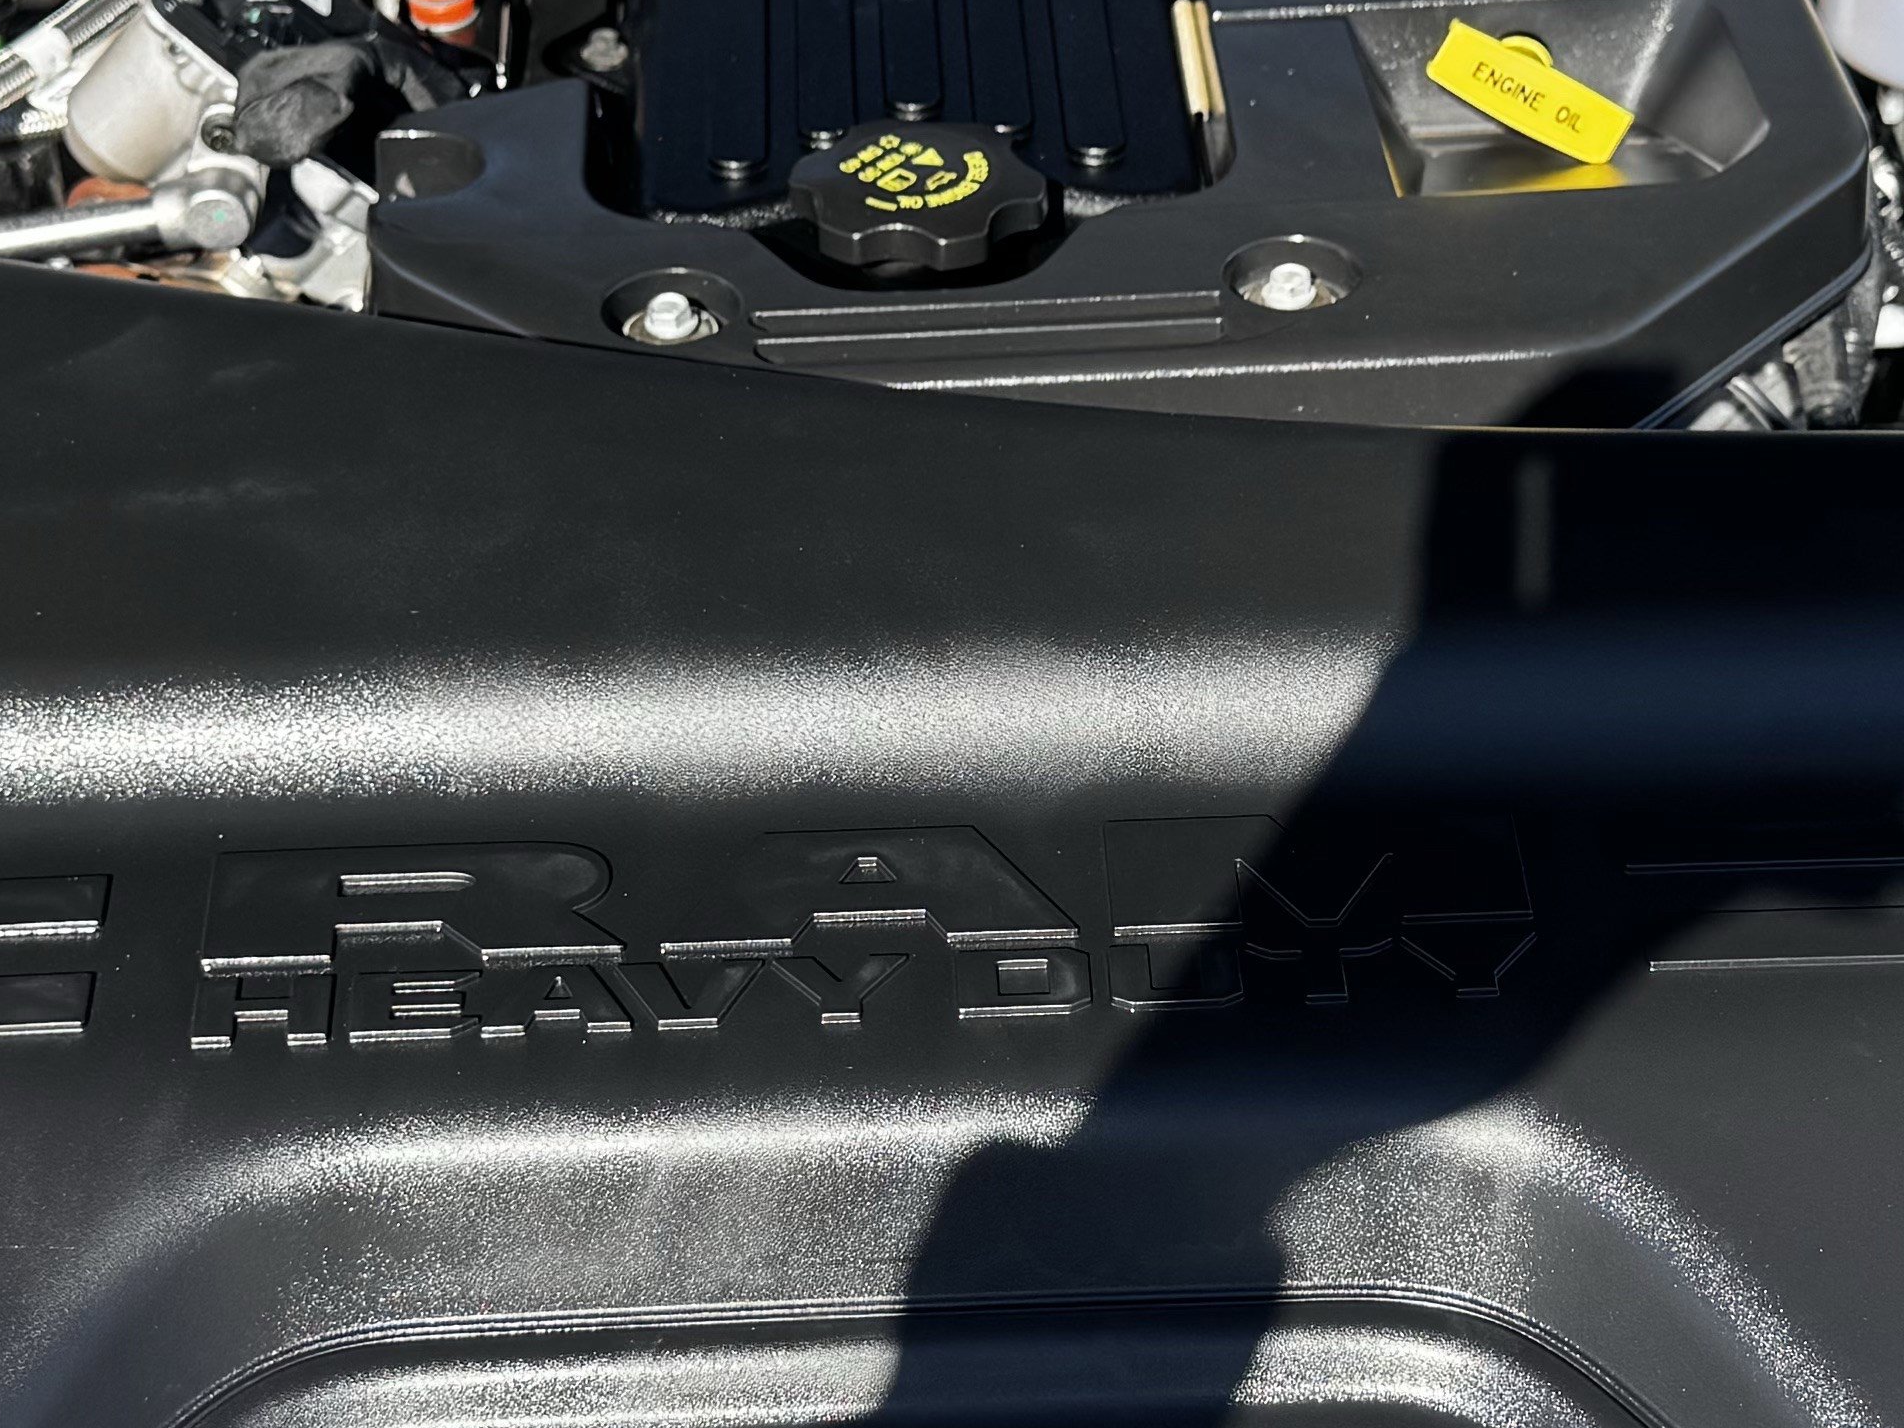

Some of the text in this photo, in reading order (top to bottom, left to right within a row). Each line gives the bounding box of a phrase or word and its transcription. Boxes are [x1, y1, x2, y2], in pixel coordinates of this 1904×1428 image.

[1471, 60, 1582, 134] ENGINE OIL
[201, 812, 1534, 976] RAM
[190, 930, 1538, 1049] HEAVY DUTY
